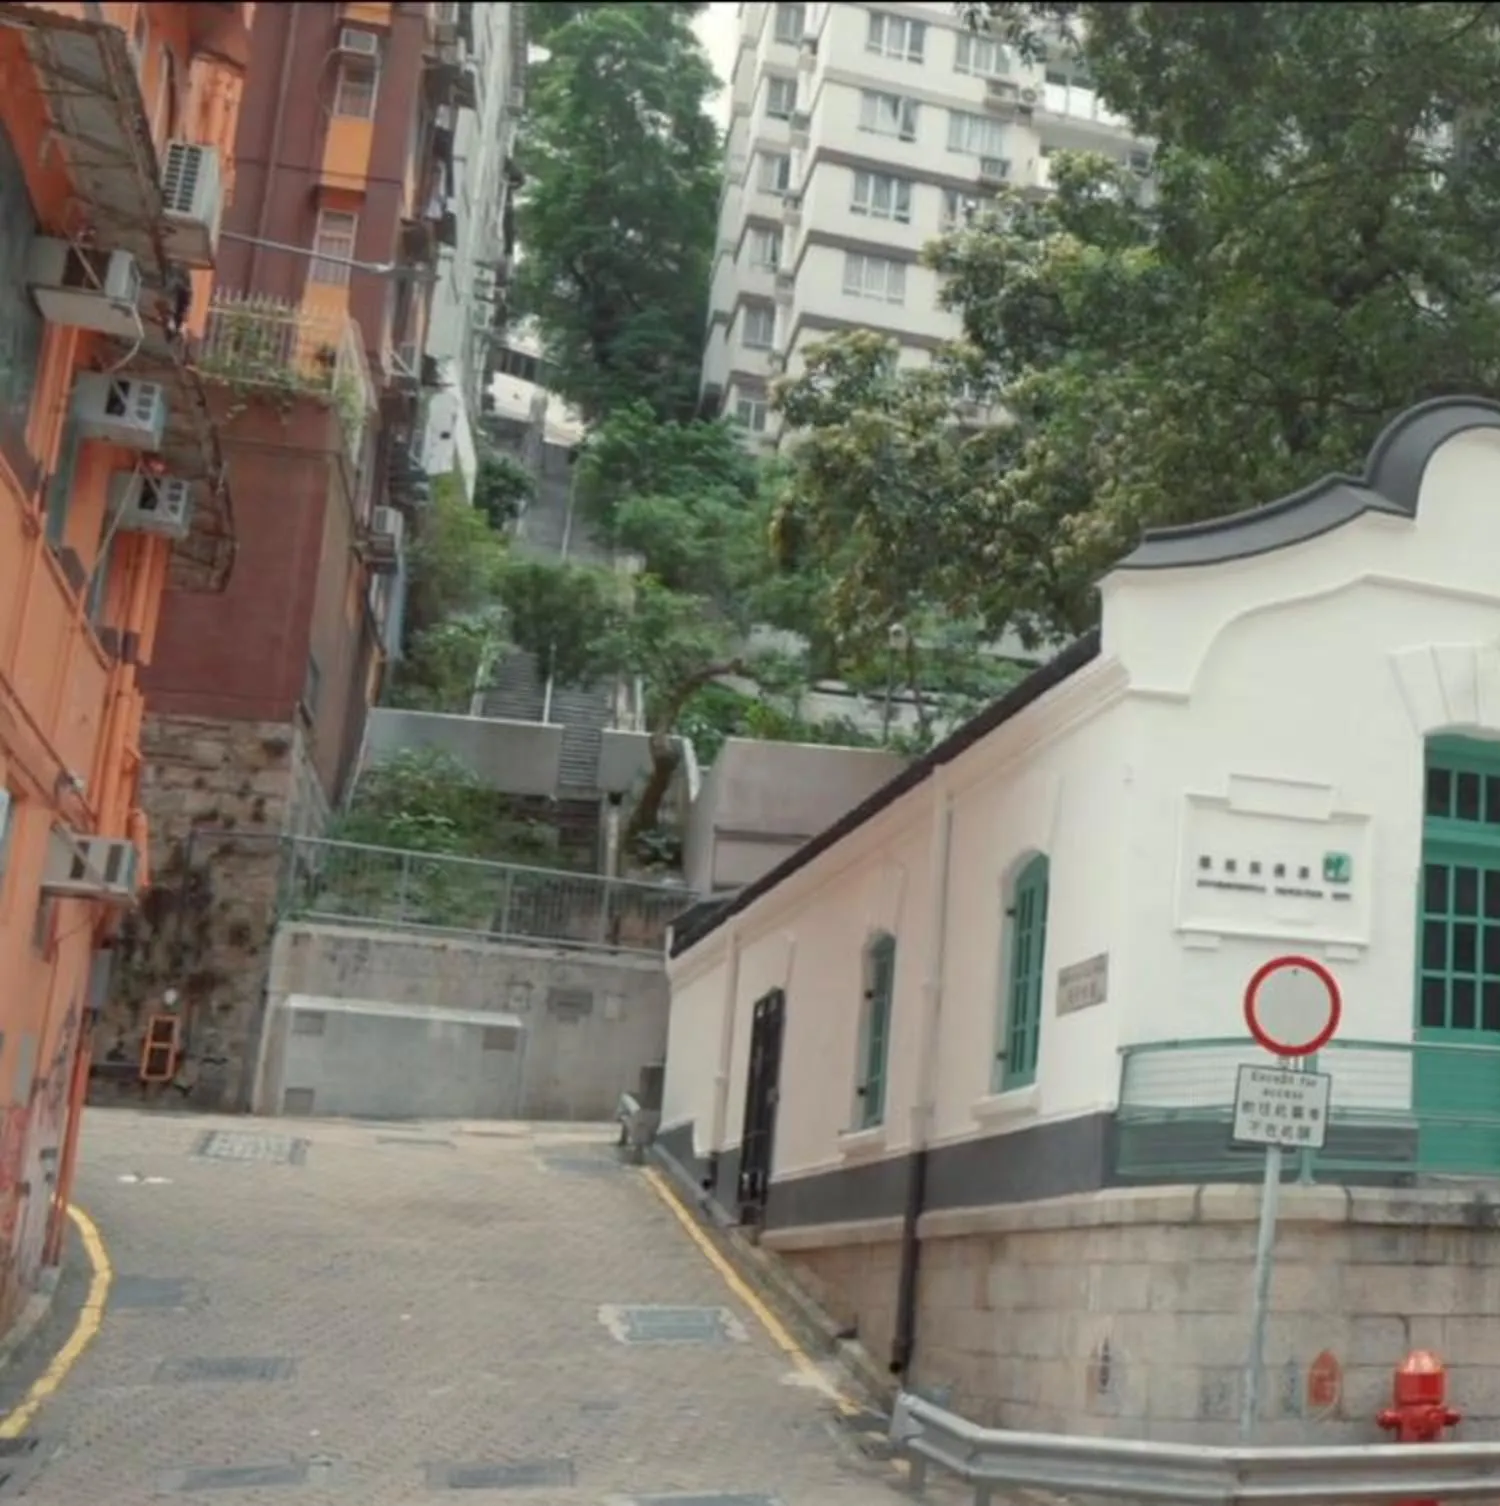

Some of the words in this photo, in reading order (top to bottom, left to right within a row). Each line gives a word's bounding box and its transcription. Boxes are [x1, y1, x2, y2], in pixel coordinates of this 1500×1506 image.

[1250, 1070, 1295, 1085] Except
[1300, 1076, 1318, 1088] for
[1261, 1087, 1305, 1100] access
